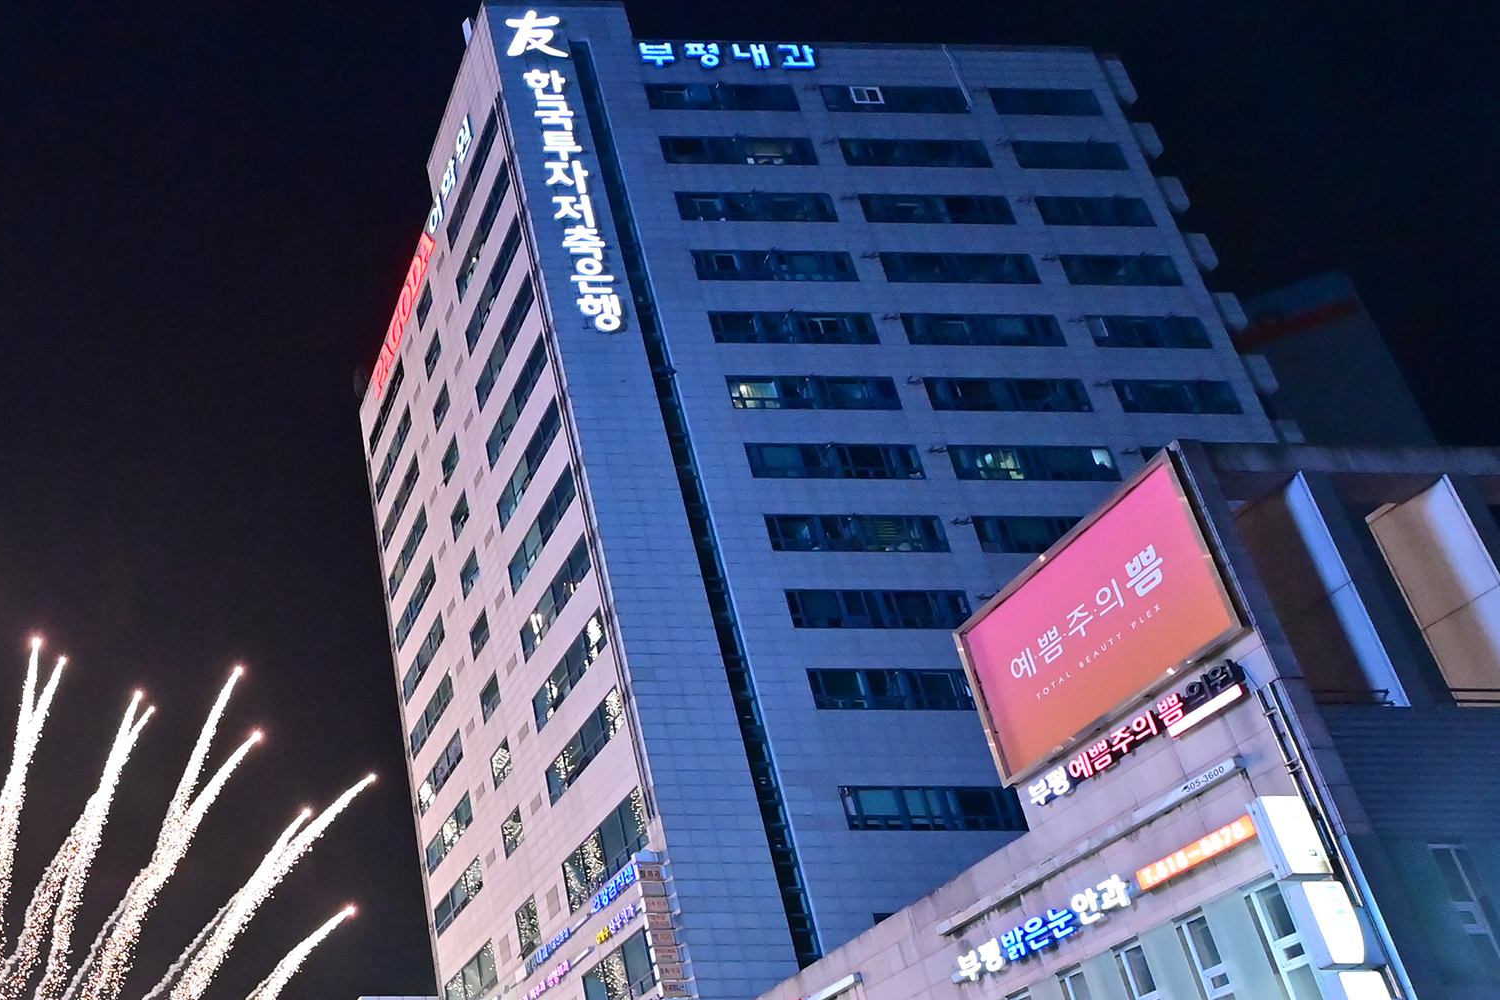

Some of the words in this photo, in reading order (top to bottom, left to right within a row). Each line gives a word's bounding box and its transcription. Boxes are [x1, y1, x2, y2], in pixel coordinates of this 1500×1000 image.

[638, 42, 816, 69] 부평내과
[522, 69, 622, 332] 한국투자저축은행
[372, 231, 436, 400] PAGODA
[428, 114, 473, 234] 어학원
[1036, 671, 1071, 700] TOTAL
[1078, 632, 1122, 669] BEAUTY
[1130, 603, 1161, 630] PLEX
[591, 863, 641, 914] 건강검진센
